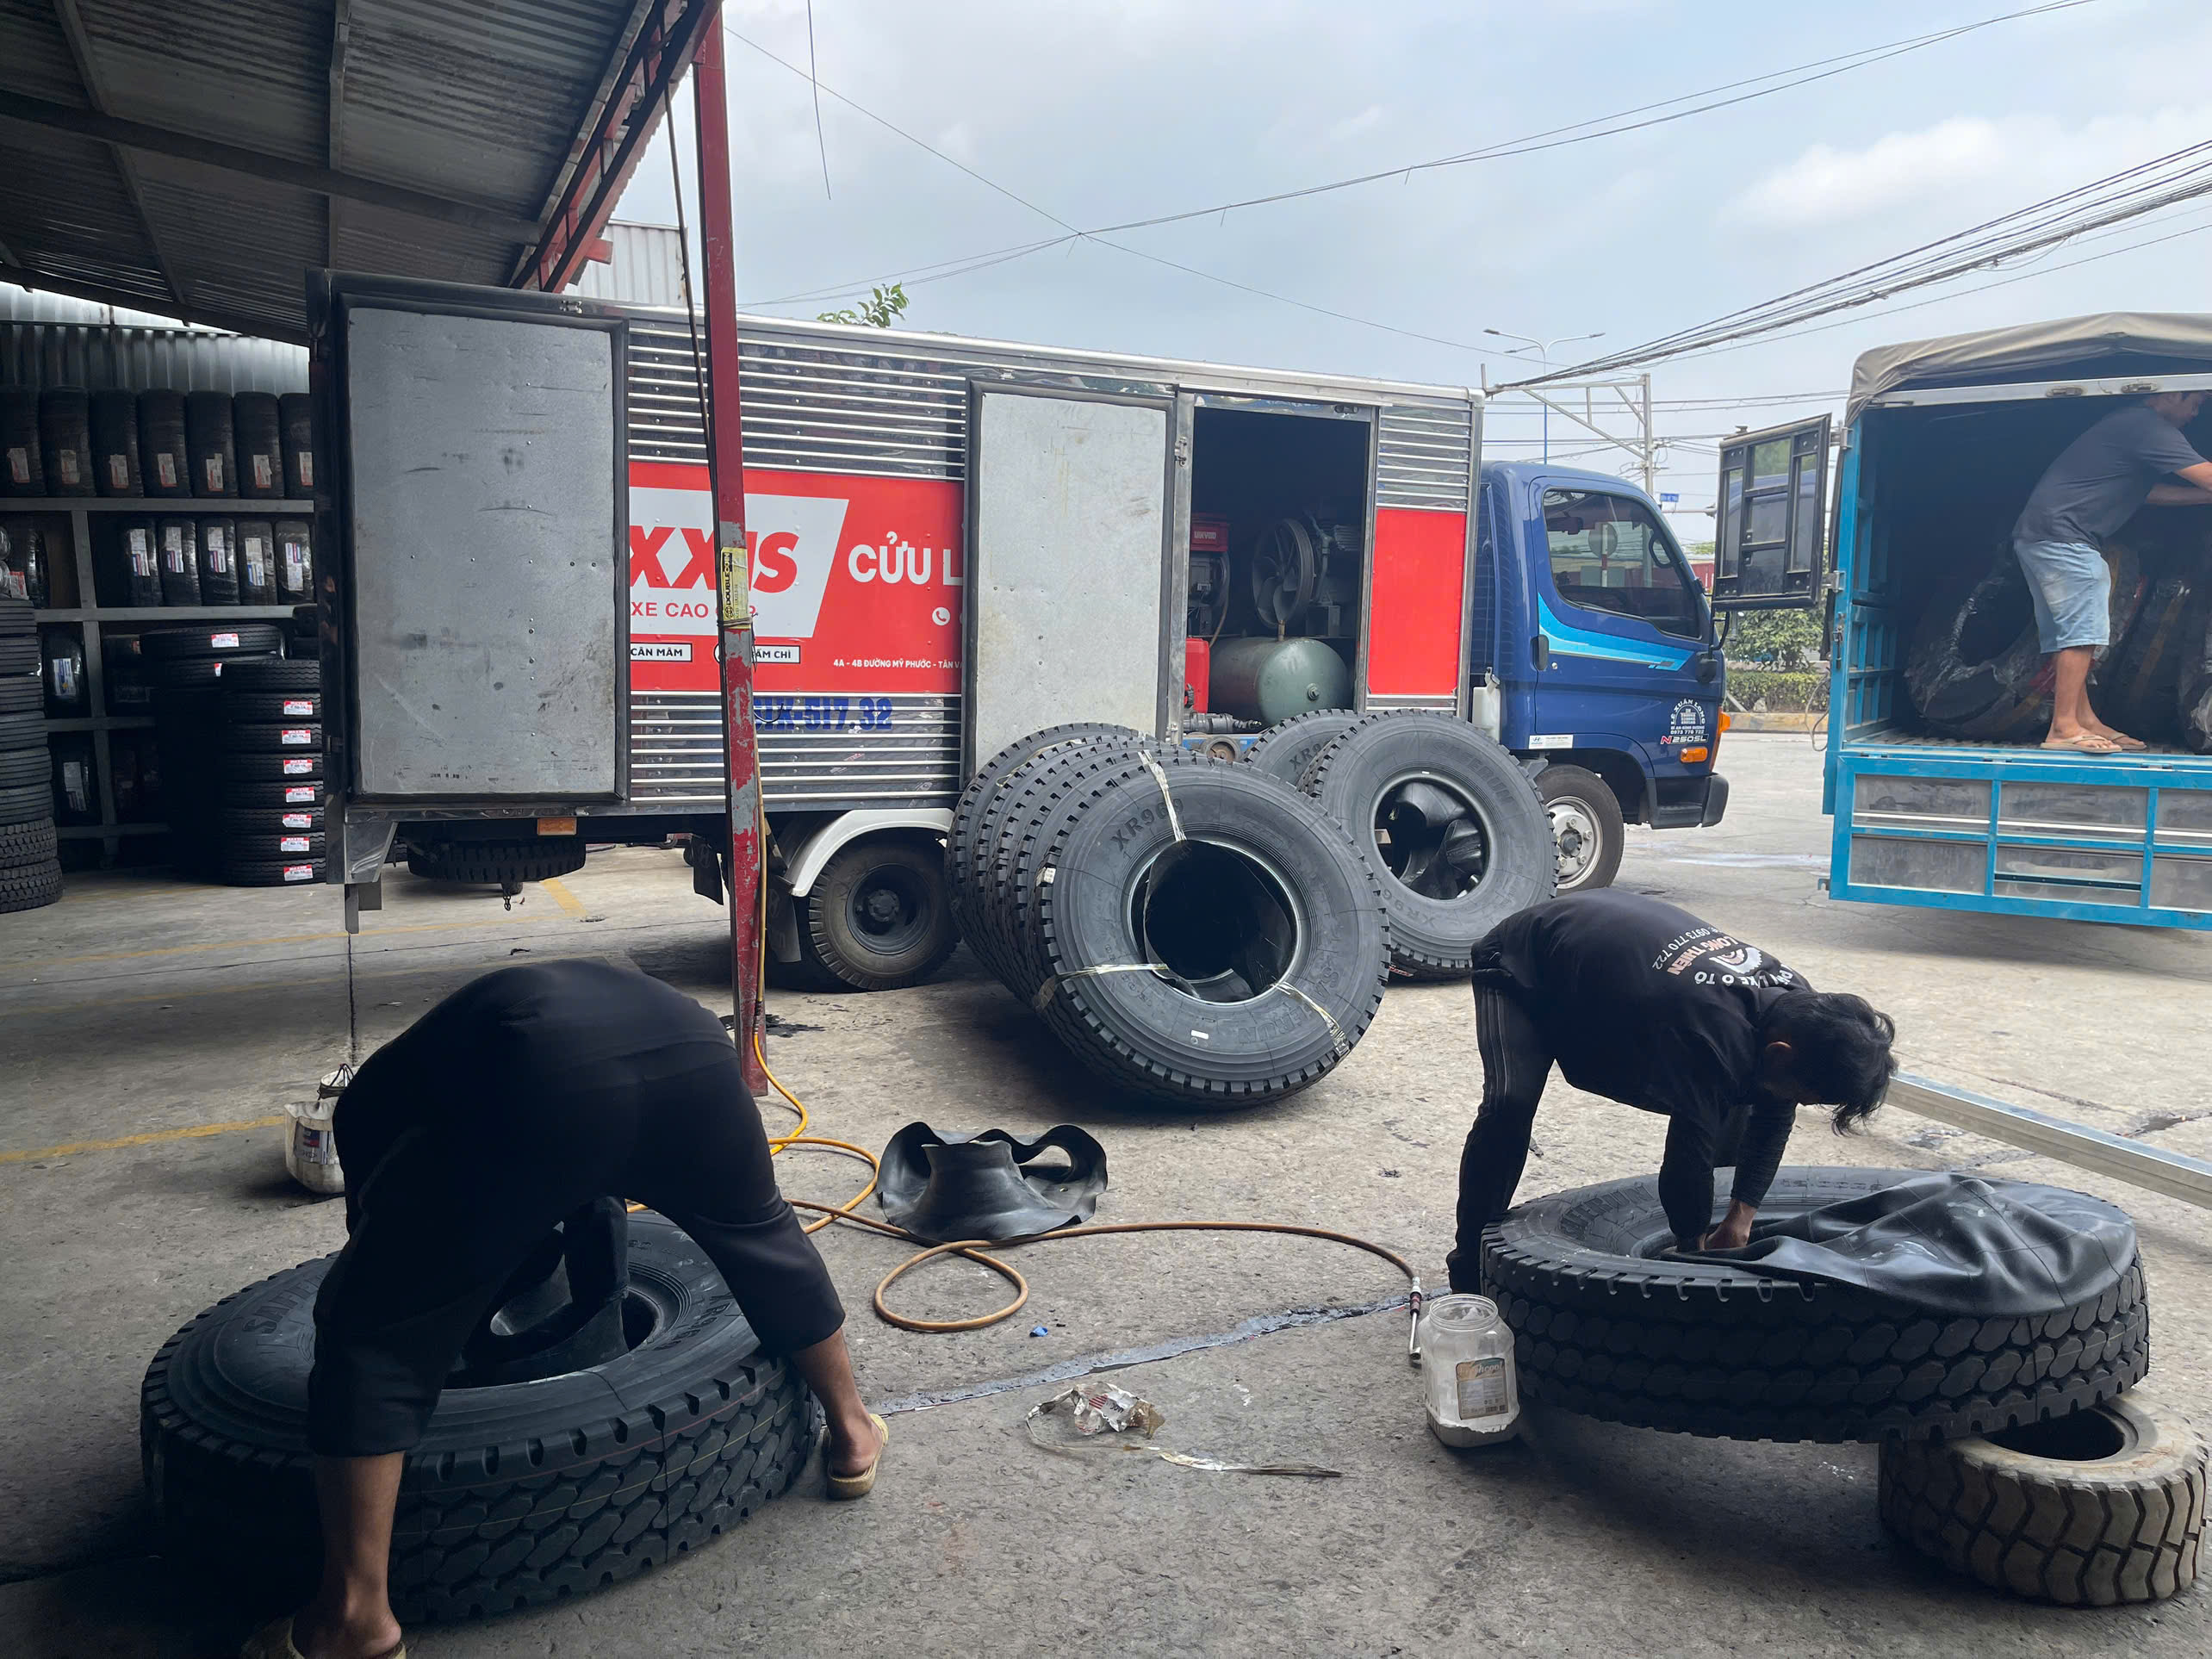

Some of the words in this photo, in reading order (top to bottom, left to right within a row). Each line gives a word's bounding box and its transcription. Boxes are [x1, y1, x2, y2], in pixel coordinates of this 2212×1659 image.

[848, 531, 931, 585] CỬU
[942, 549, 964, 586] L
[631, 602, 657, 617] XE
[665, 602, 709, 618] CAO
[631, 646, 653, 656] CÂN
[656, 647, 682, 657] MÂM
[1685, 928, 1711, 940] 0973
[1668, 935, 1689, 951] 770
[1699, 935, 1739, 952] LONG
[1651, 949, 1673, 970] 722
